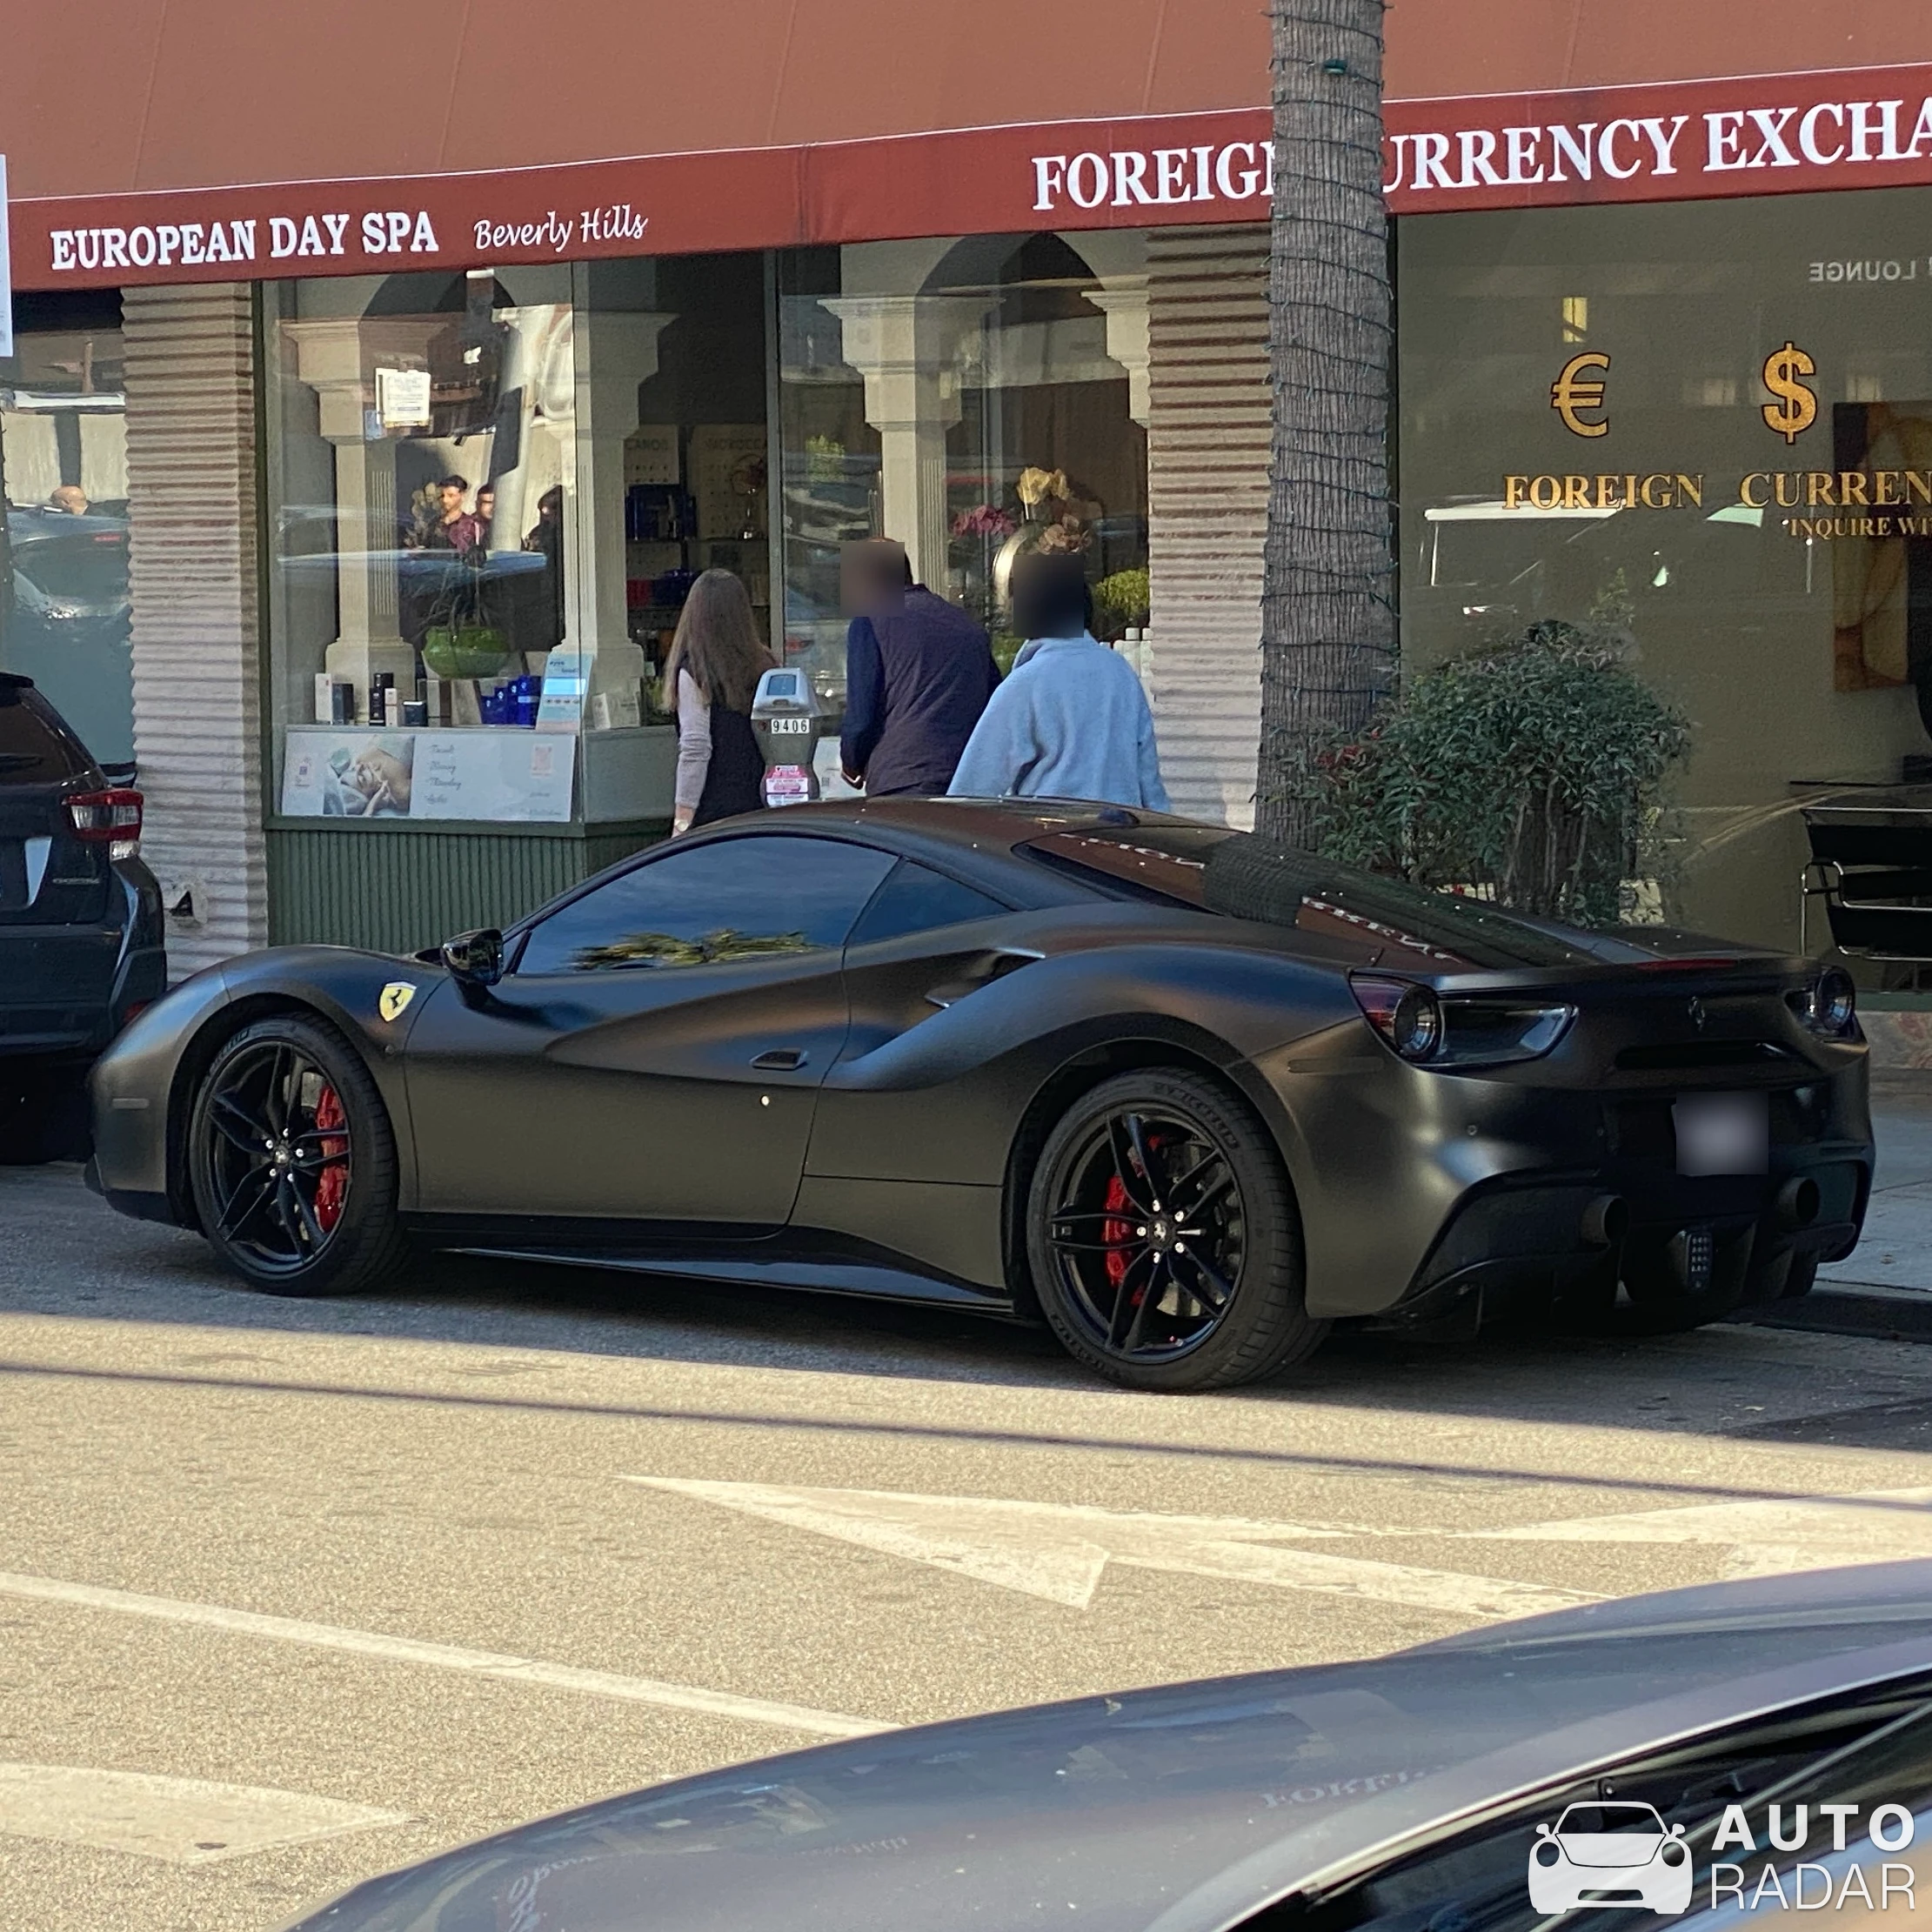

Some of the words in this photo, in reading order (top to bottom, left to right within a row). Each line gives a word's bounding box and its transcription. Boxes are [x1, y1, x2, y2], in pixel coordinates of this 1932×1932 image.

[1031, 140, 1275, 212] FOREIG
[1381, 115, 1690, 194] URRENCY
[1700, 96, 1932, 172] EXCHA
[50, 219, 257, 271] EUROPEAN
[269, 212, 351, 258] DAY
[361, 211, 439, 254] SPA
[473, 211, 573, 253] Beverly
[579, 203, 649, 244] Hills
[1502, 474, 1703, 511] FOREIGN
[1739, 471, 1932, 509] CURREN
[1789, 516, 1892, 540] INQUIRE
[1897, 516, 1932, 536] WI
[772, 719, 807, 733] 9406
